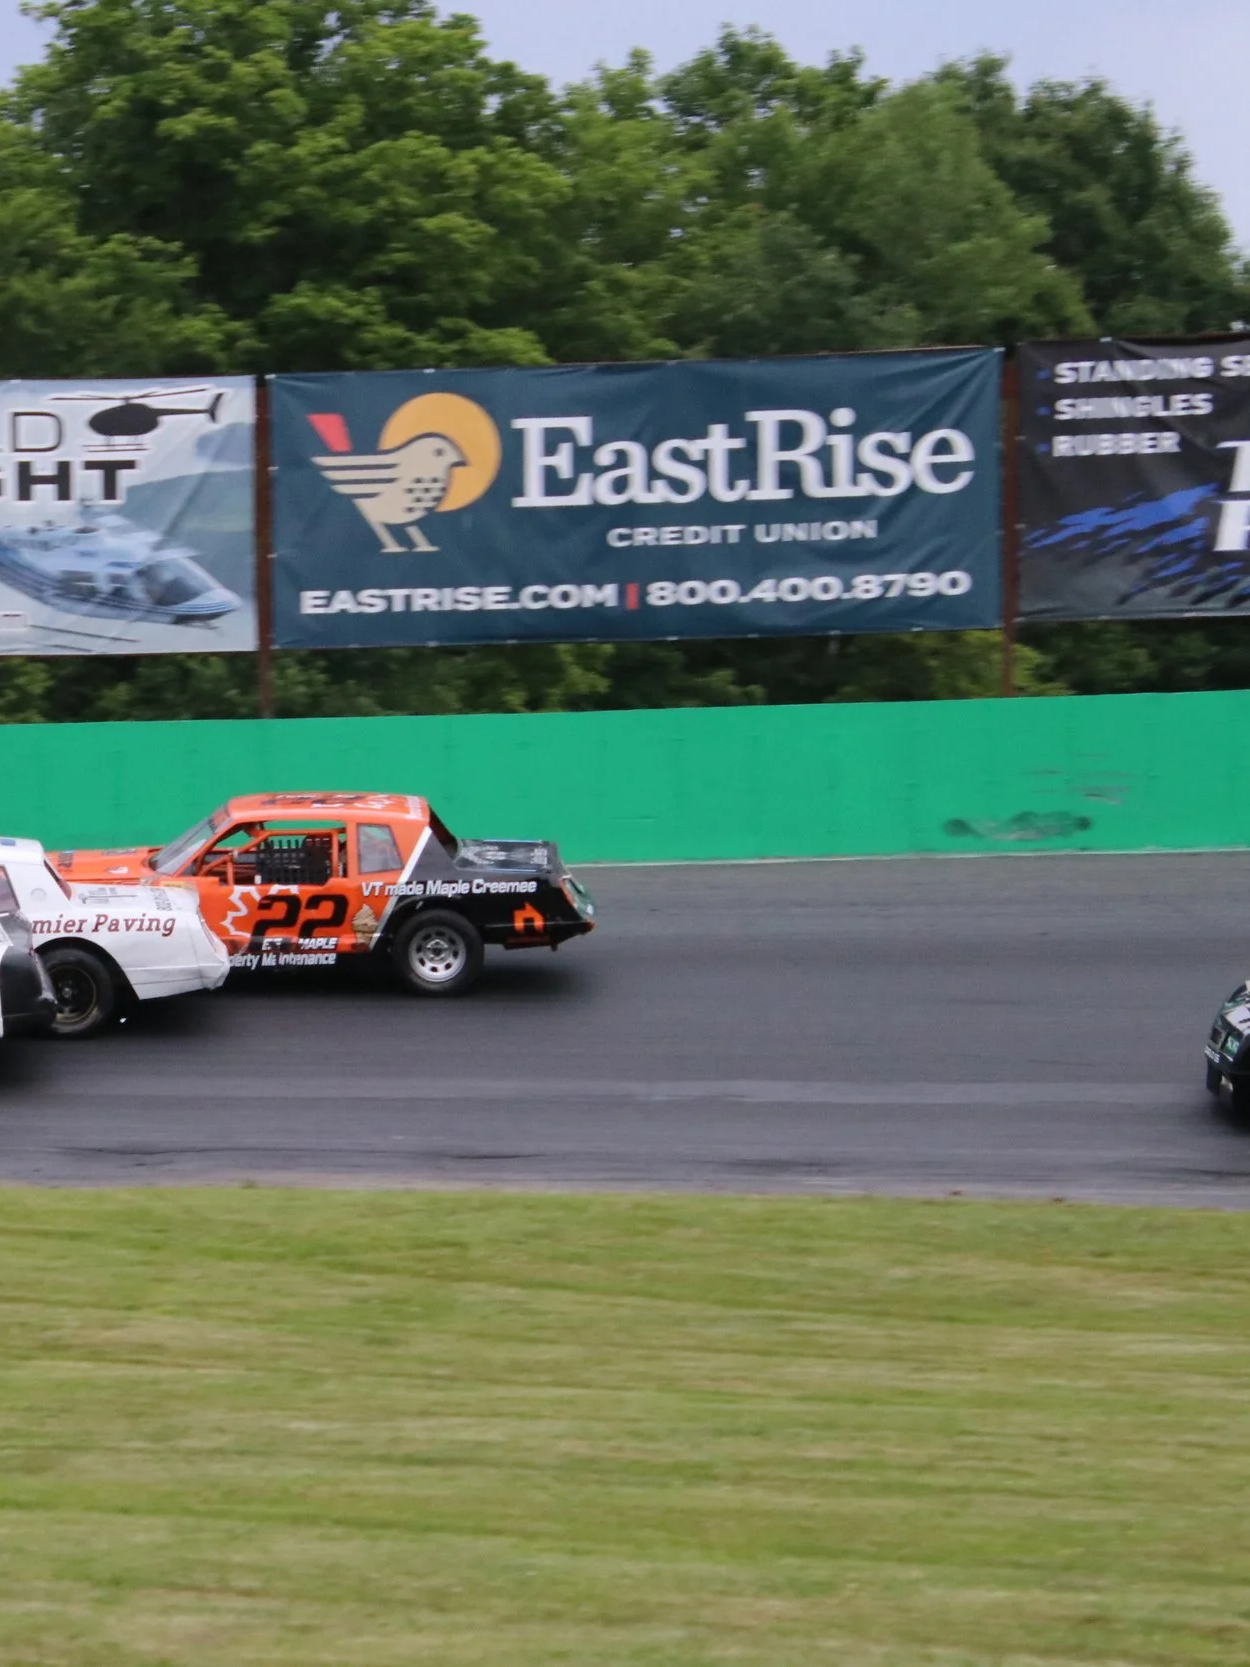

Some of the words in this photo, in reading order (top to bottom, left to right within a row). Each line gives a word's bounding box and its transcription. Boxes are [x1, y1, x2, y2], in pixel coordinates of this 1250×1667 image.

[1053, 393, 1213, 420] SHINGLES
[511, 407, 976, 508] EastRise
[1052, 432, 1181, 457] RUBBER
[606, 524, 745, 549] CREDIT
[755, 519, 878, 544] UNION
[300, 583, 618, 615] EASTRISE.COM
[646, 570, 972, 605] 800.400.8790
[362, 882, 383, 897] VT
[385, 882, 423, 896] made
[426, 880, 470, 898] Maple
[472, 879, 537, 894] Creemee
[31, 914, 88, 934] mier
[92, 913, 176, 937] Paving
[251, 894, 349, 939] 22
